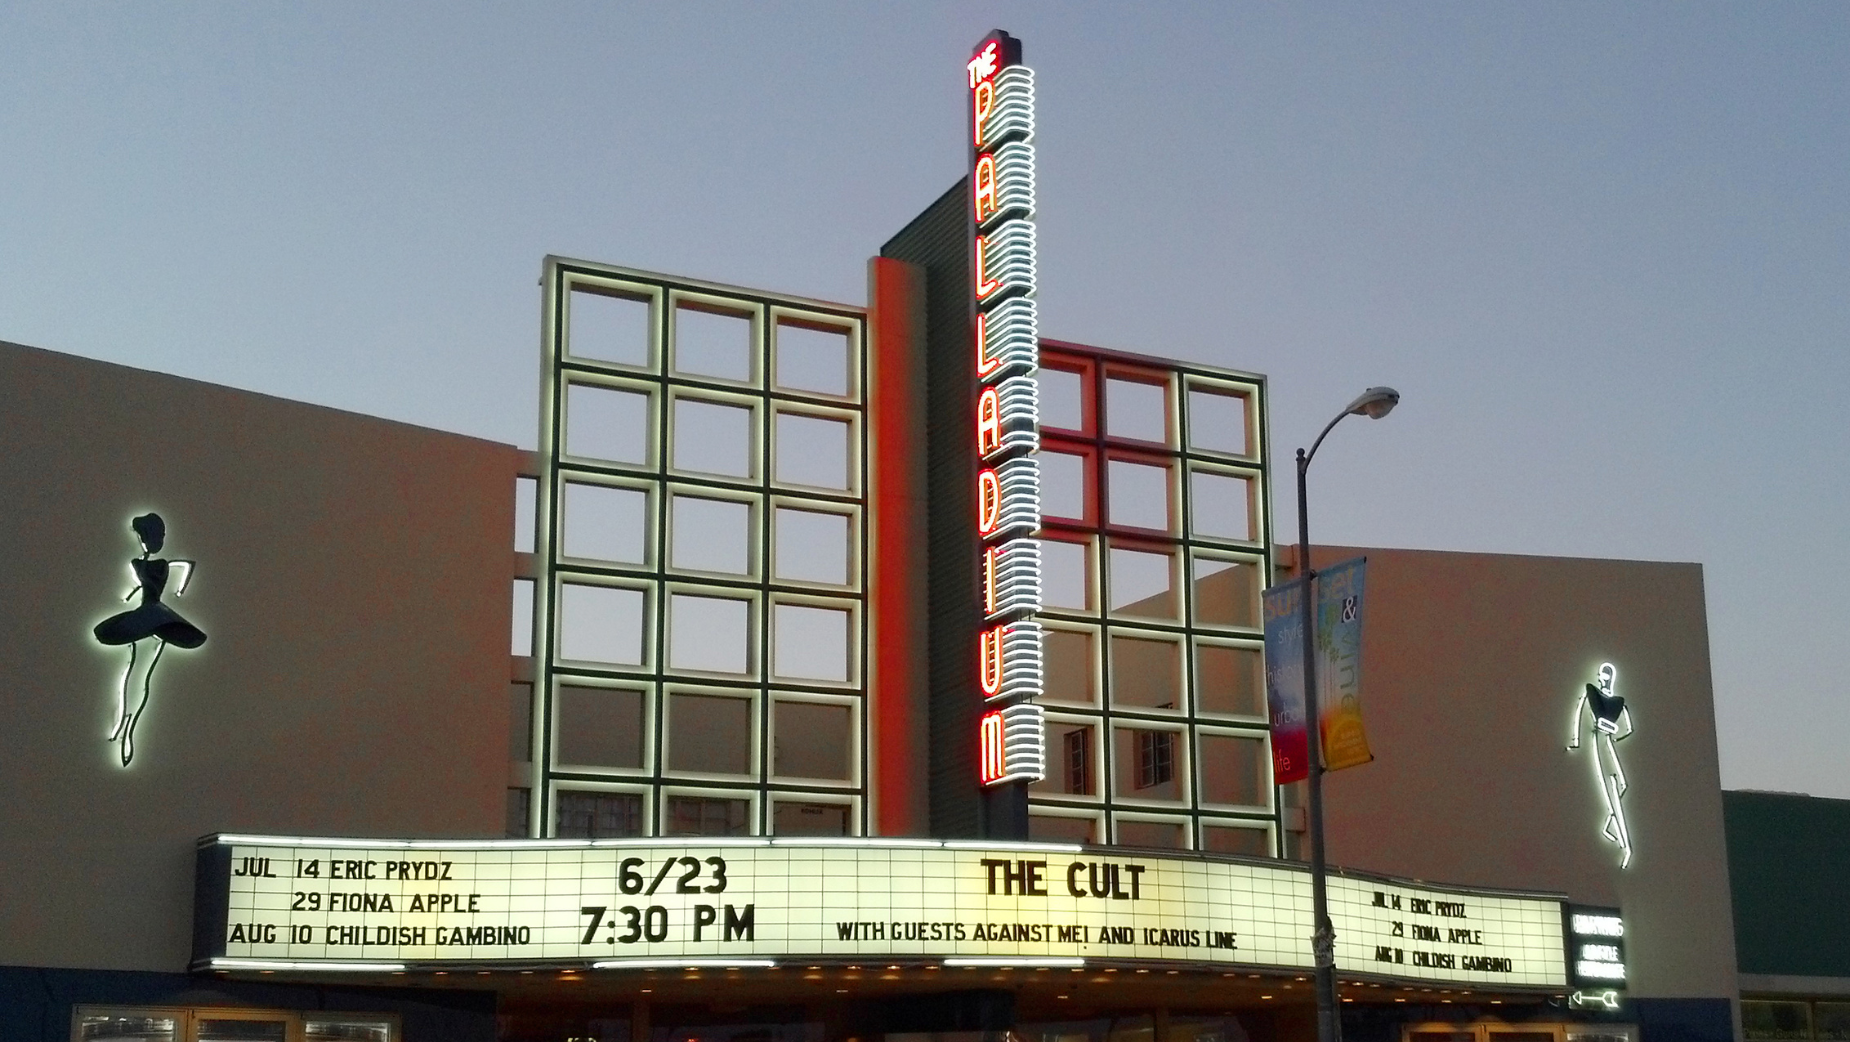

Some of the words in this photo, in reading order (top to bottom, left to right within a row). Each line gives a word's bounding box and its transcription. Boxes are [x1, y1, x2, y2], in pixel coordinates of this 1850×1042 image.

[966, 41, 998, 89] THE
[973, 80, 1005, 786] PALLADIUM
[1342, 596, 1357, 623] &
[1273, 748, 1291, 773] life
[234, 857, 277, 878] JUL
[296, 859, 320, 879] 14
[330, 860, 378, 880] ERIC
[386, 861, 453, 881] PRYDZ
[618, 856, 728, 896] 6/23
[980, 858, 1047, 897] THE
[1067, 861, 1145, 900] CULT
[292, 892, 321, 912] 29
[329, 893, 394, 912] FIONA
[409, 893, 481, 913] APPLE
[1391, 893, 1402, 911] 14
[1411, 897, 1432, 915] ERIC
[1435, 900, 1468, 919] PRYDZ
[228, 923, 277, 944] AUG
[291, 924, 313, 945] 10
[326, 925, 426, 946] CHILDISH
[436, 925, 531, 946] GAMBINO
[581, 904, 668, 945] 7:30
[693, 904, 755, 942] PM
[836, 921, 885, 941] WITH
[890, 922, 966, 941] GUESTS
[972, 923, 1053, 942] AGAINST
[1057, 924, 1089, 950] ME!
[1099, 926, 1135, 945] AND
[1144, 927, 1201, 947] ICARUS
[1206, 930, 1238, 950] LINE
[1392, 920, 1404, 938] 29
[1411, 924, 1442, 943] FIONA
[1448, 928, 1483, 946] APPLE
[1413, 950, 1456, 970] CHILDISH
[1461, 955, 1512, 973] GAMBINO
